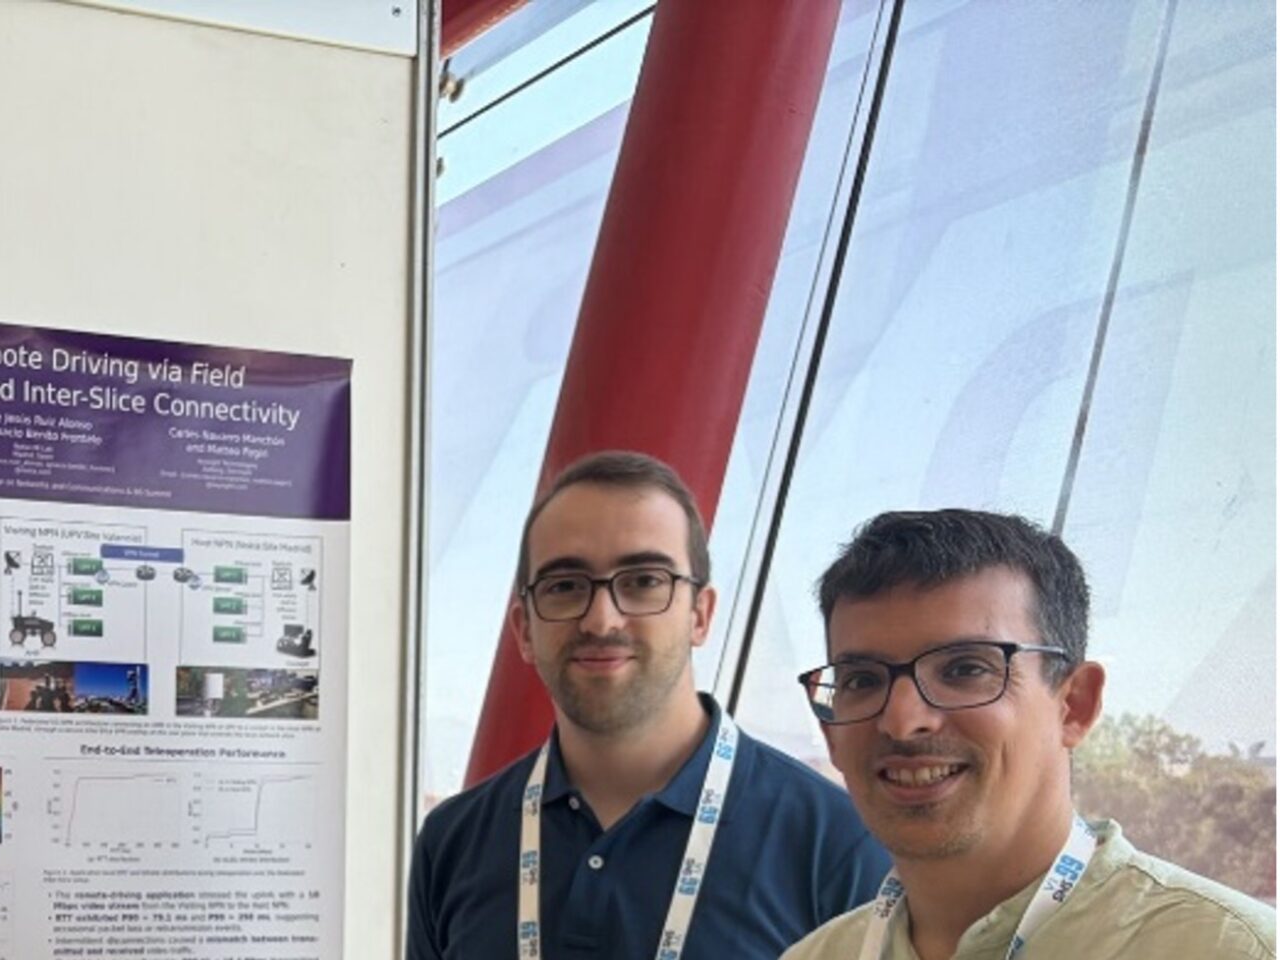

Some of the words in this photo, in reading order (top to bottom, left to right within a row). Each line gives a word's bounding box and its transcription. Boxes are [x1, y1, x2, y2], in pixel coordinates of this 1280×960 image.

[52, 348, 138, 383] Driving
[148, 357, 182, 382] via
[190, 362, 246, 389] Field
[23, 380, 146, 414] Inter-Slice
[153, 393, 300, 431] Connectivity
[185, 443, 205, 454] and
[79, 743, 141, 757] End-to-End
[144, 745, 216, 758] Teleoperation
[219, 747, 287, 760] Performance
[1054, 853, 1086, 881] 6G
